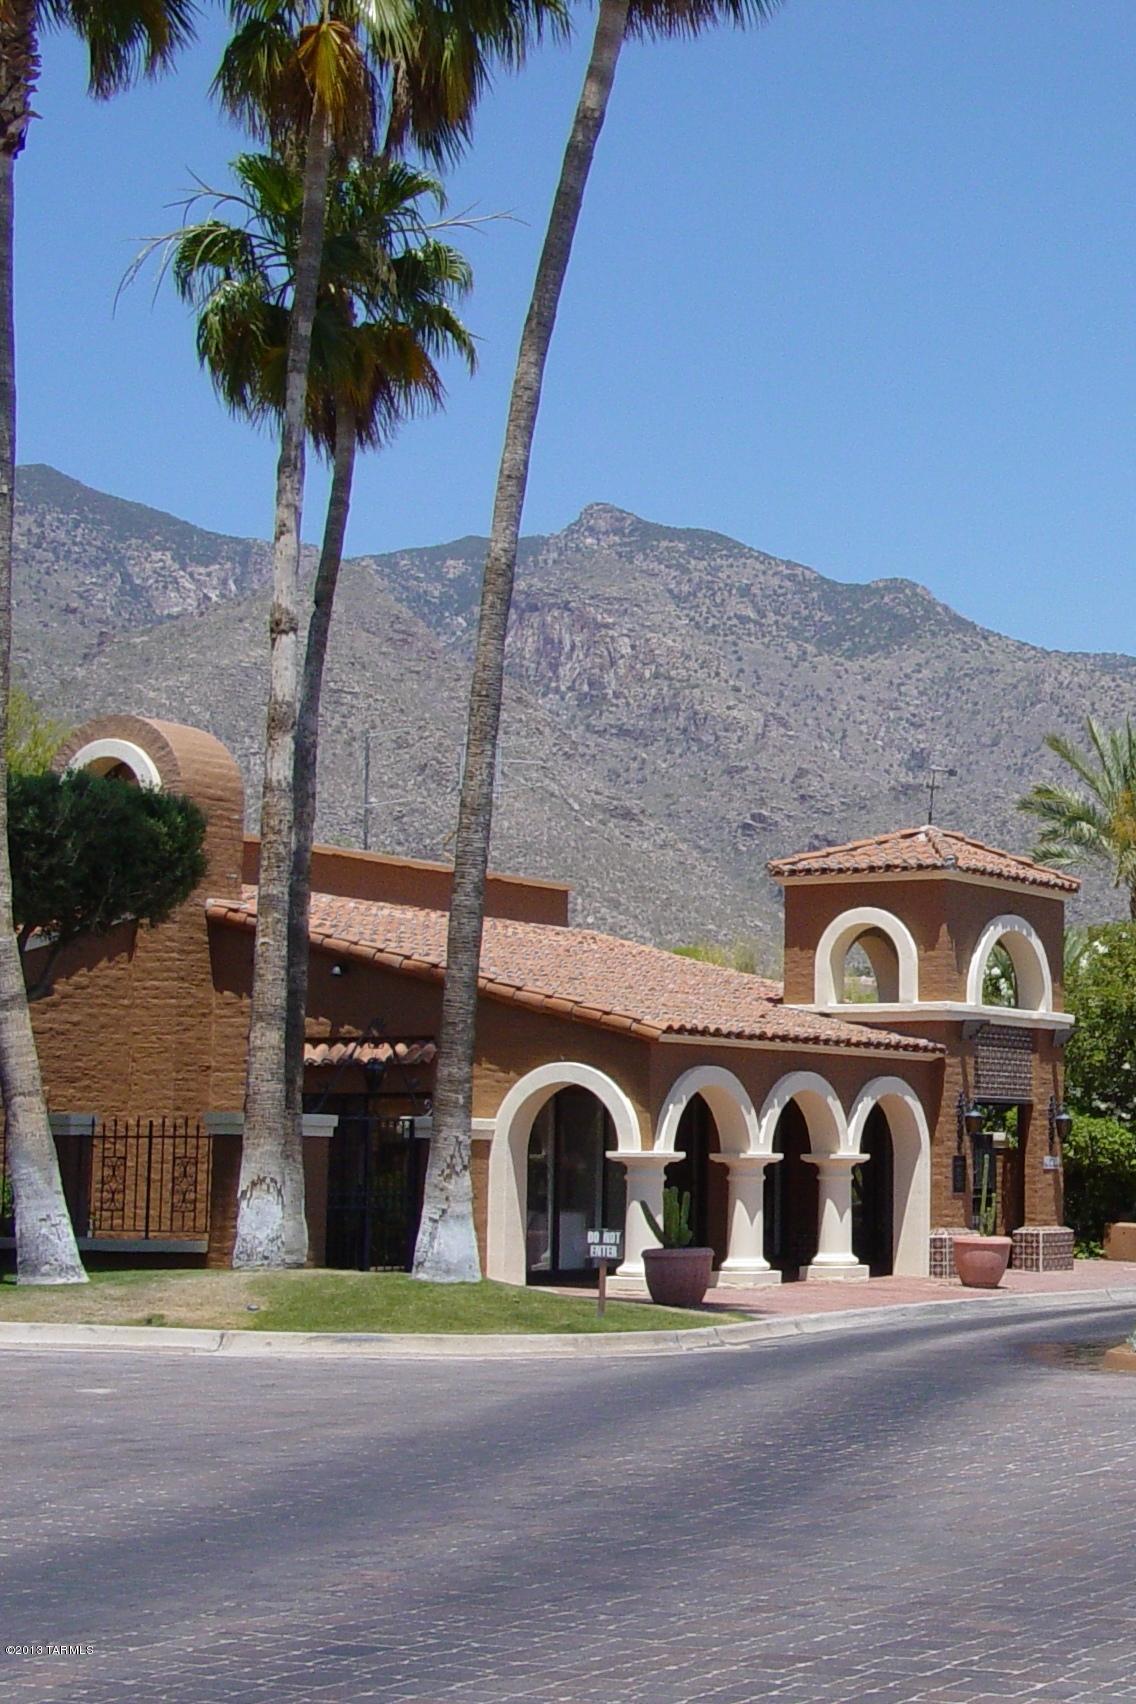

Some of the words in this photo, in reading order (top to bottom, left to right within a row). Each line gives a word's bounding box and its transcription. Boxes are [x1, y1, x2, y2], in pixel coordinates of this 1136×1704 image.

[587, 1230, 600, 1244] DO
[602, 1231, 622, 1245] NOT
[590, 1245, 618, 1258] ENTER
